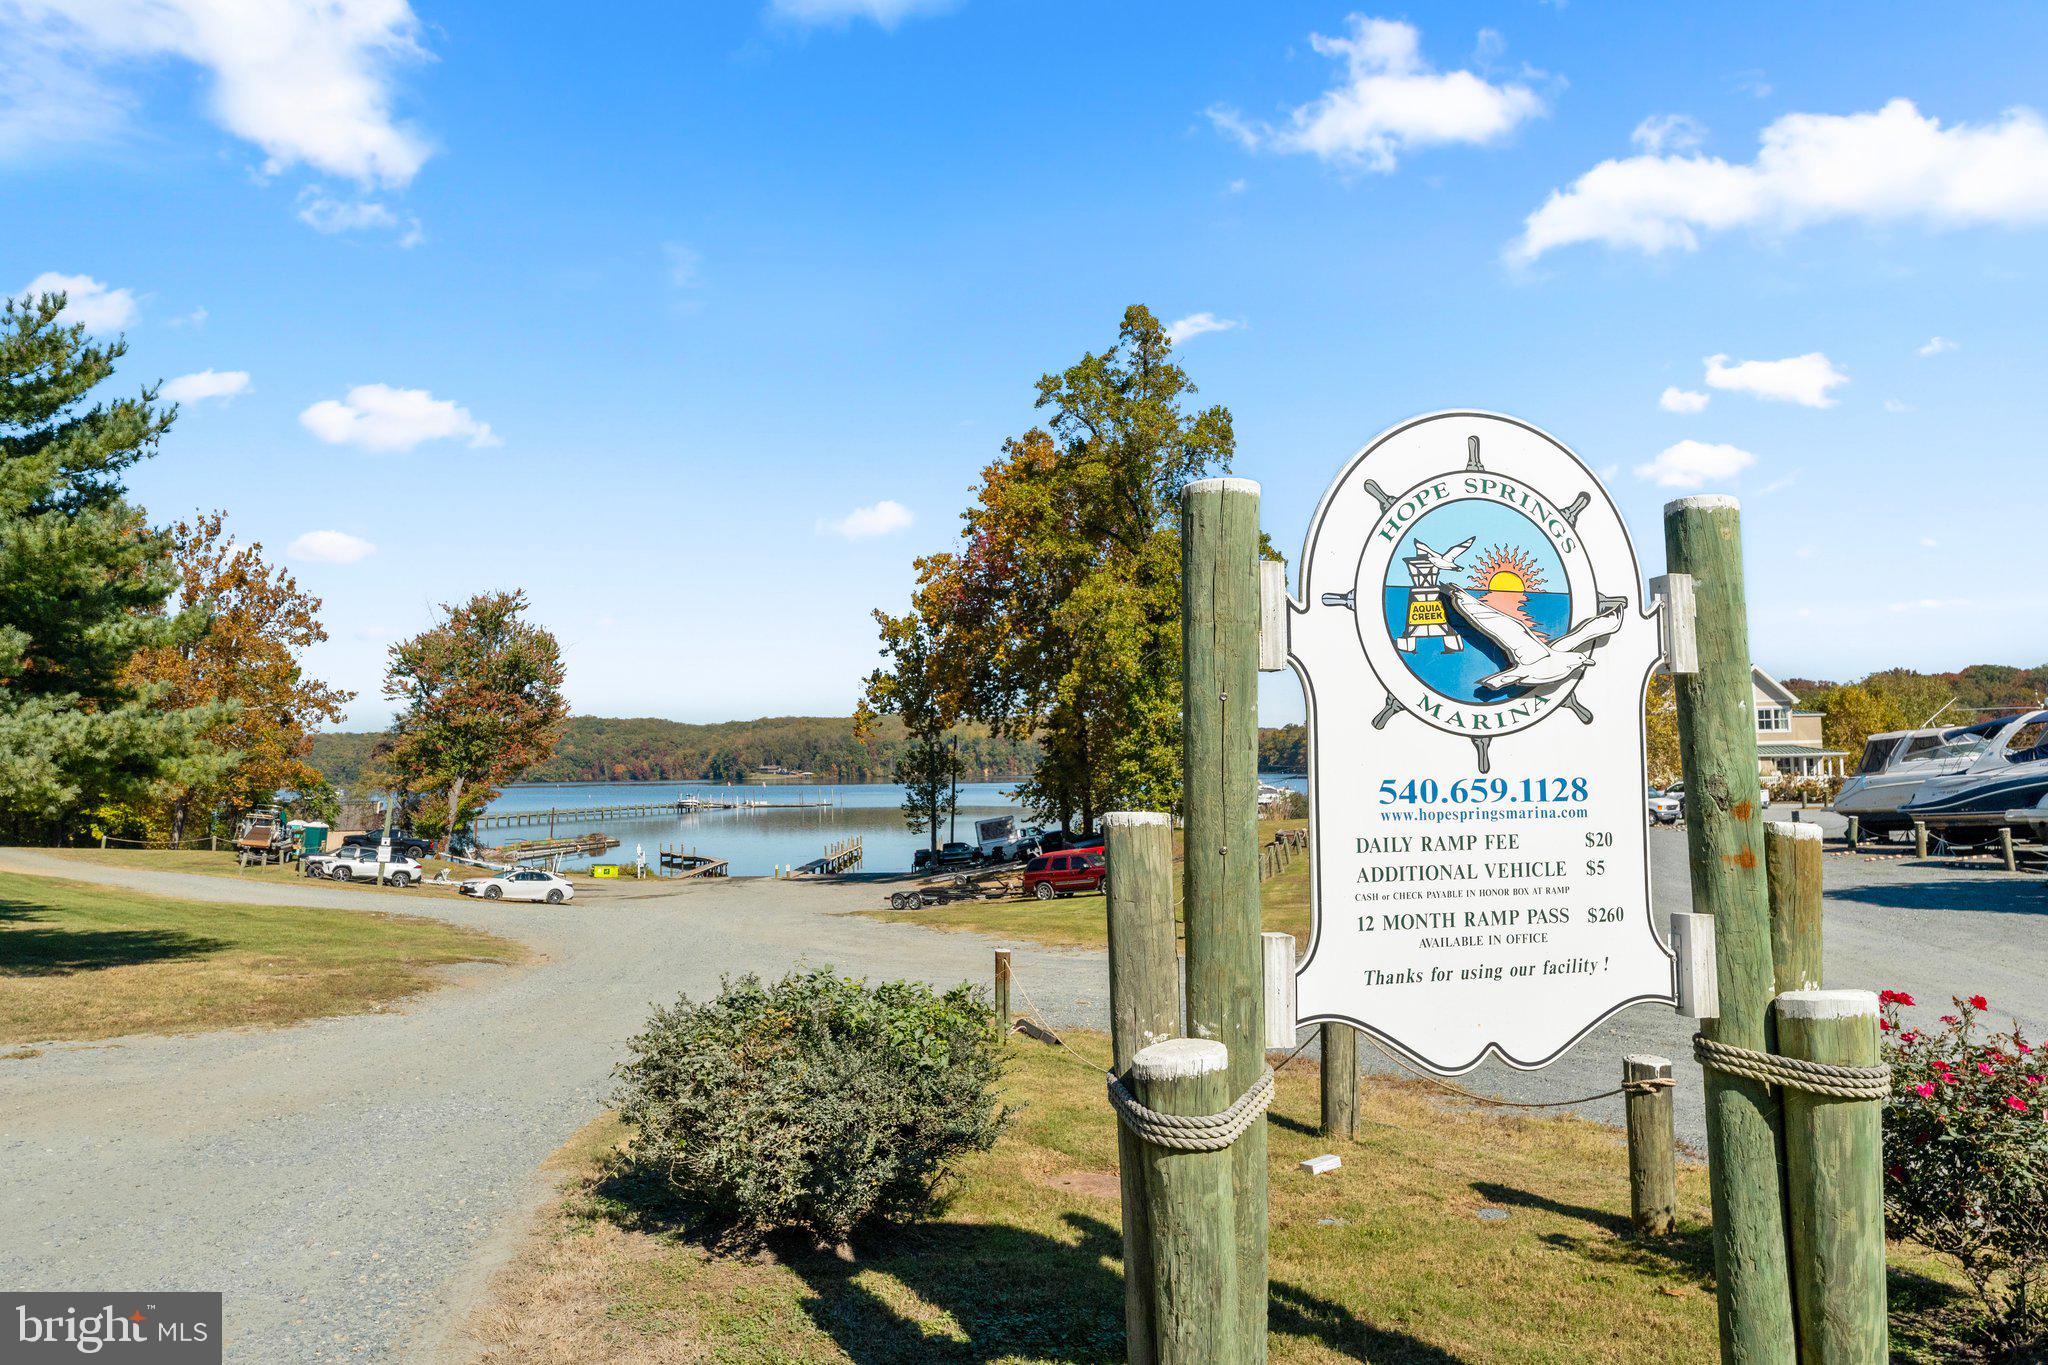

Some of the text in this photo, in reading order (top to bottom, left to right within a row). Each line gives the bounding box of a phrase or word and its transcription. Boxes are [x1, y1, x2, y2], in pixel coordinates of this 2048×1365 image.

[1378, 477, 1576, 554] HOPE SPRINGS
[1411, 612, 1443, 621] CREEK
[1412, 604, 1441, 613] AQUIA
[1416, 694, 1551, 731] MARINA
[1378, 777, 1589, 805] 540.659.1128
[1380, 807, 1588, 823] www.hopespringsmarina.com
[1356, 831, 1613, 854] DAILY RAMP FEE $20
[1356, 860, 1605, 884] ADDITIONAL VEHICLE $5
[1354, 892, 1379, 902] CASH
[1392, 891, 1423, 901] CHECK
[1426, 889, 1463, 900] PAYABLE
[1466, 889, 1476, 897] IN
[1479, 888, 1510, 897] HONOR
[1512, 887, 1530, 896] BOX
[1533, 887, 1542, 895] AT
[1545, 885, 1570, 895] RAMP
[1357, 906, 1624, 931] 12 MONTH RAMP PASS $260
[1418, 932, 1548, 949] AVAILABLE IN OFFICE
[1364, 967, 1423, 986] Thanks
[1430, 966, 1453, 982] for
[1460, 963, 1503, 982] using
[1509, 962, 1536, 978] our
